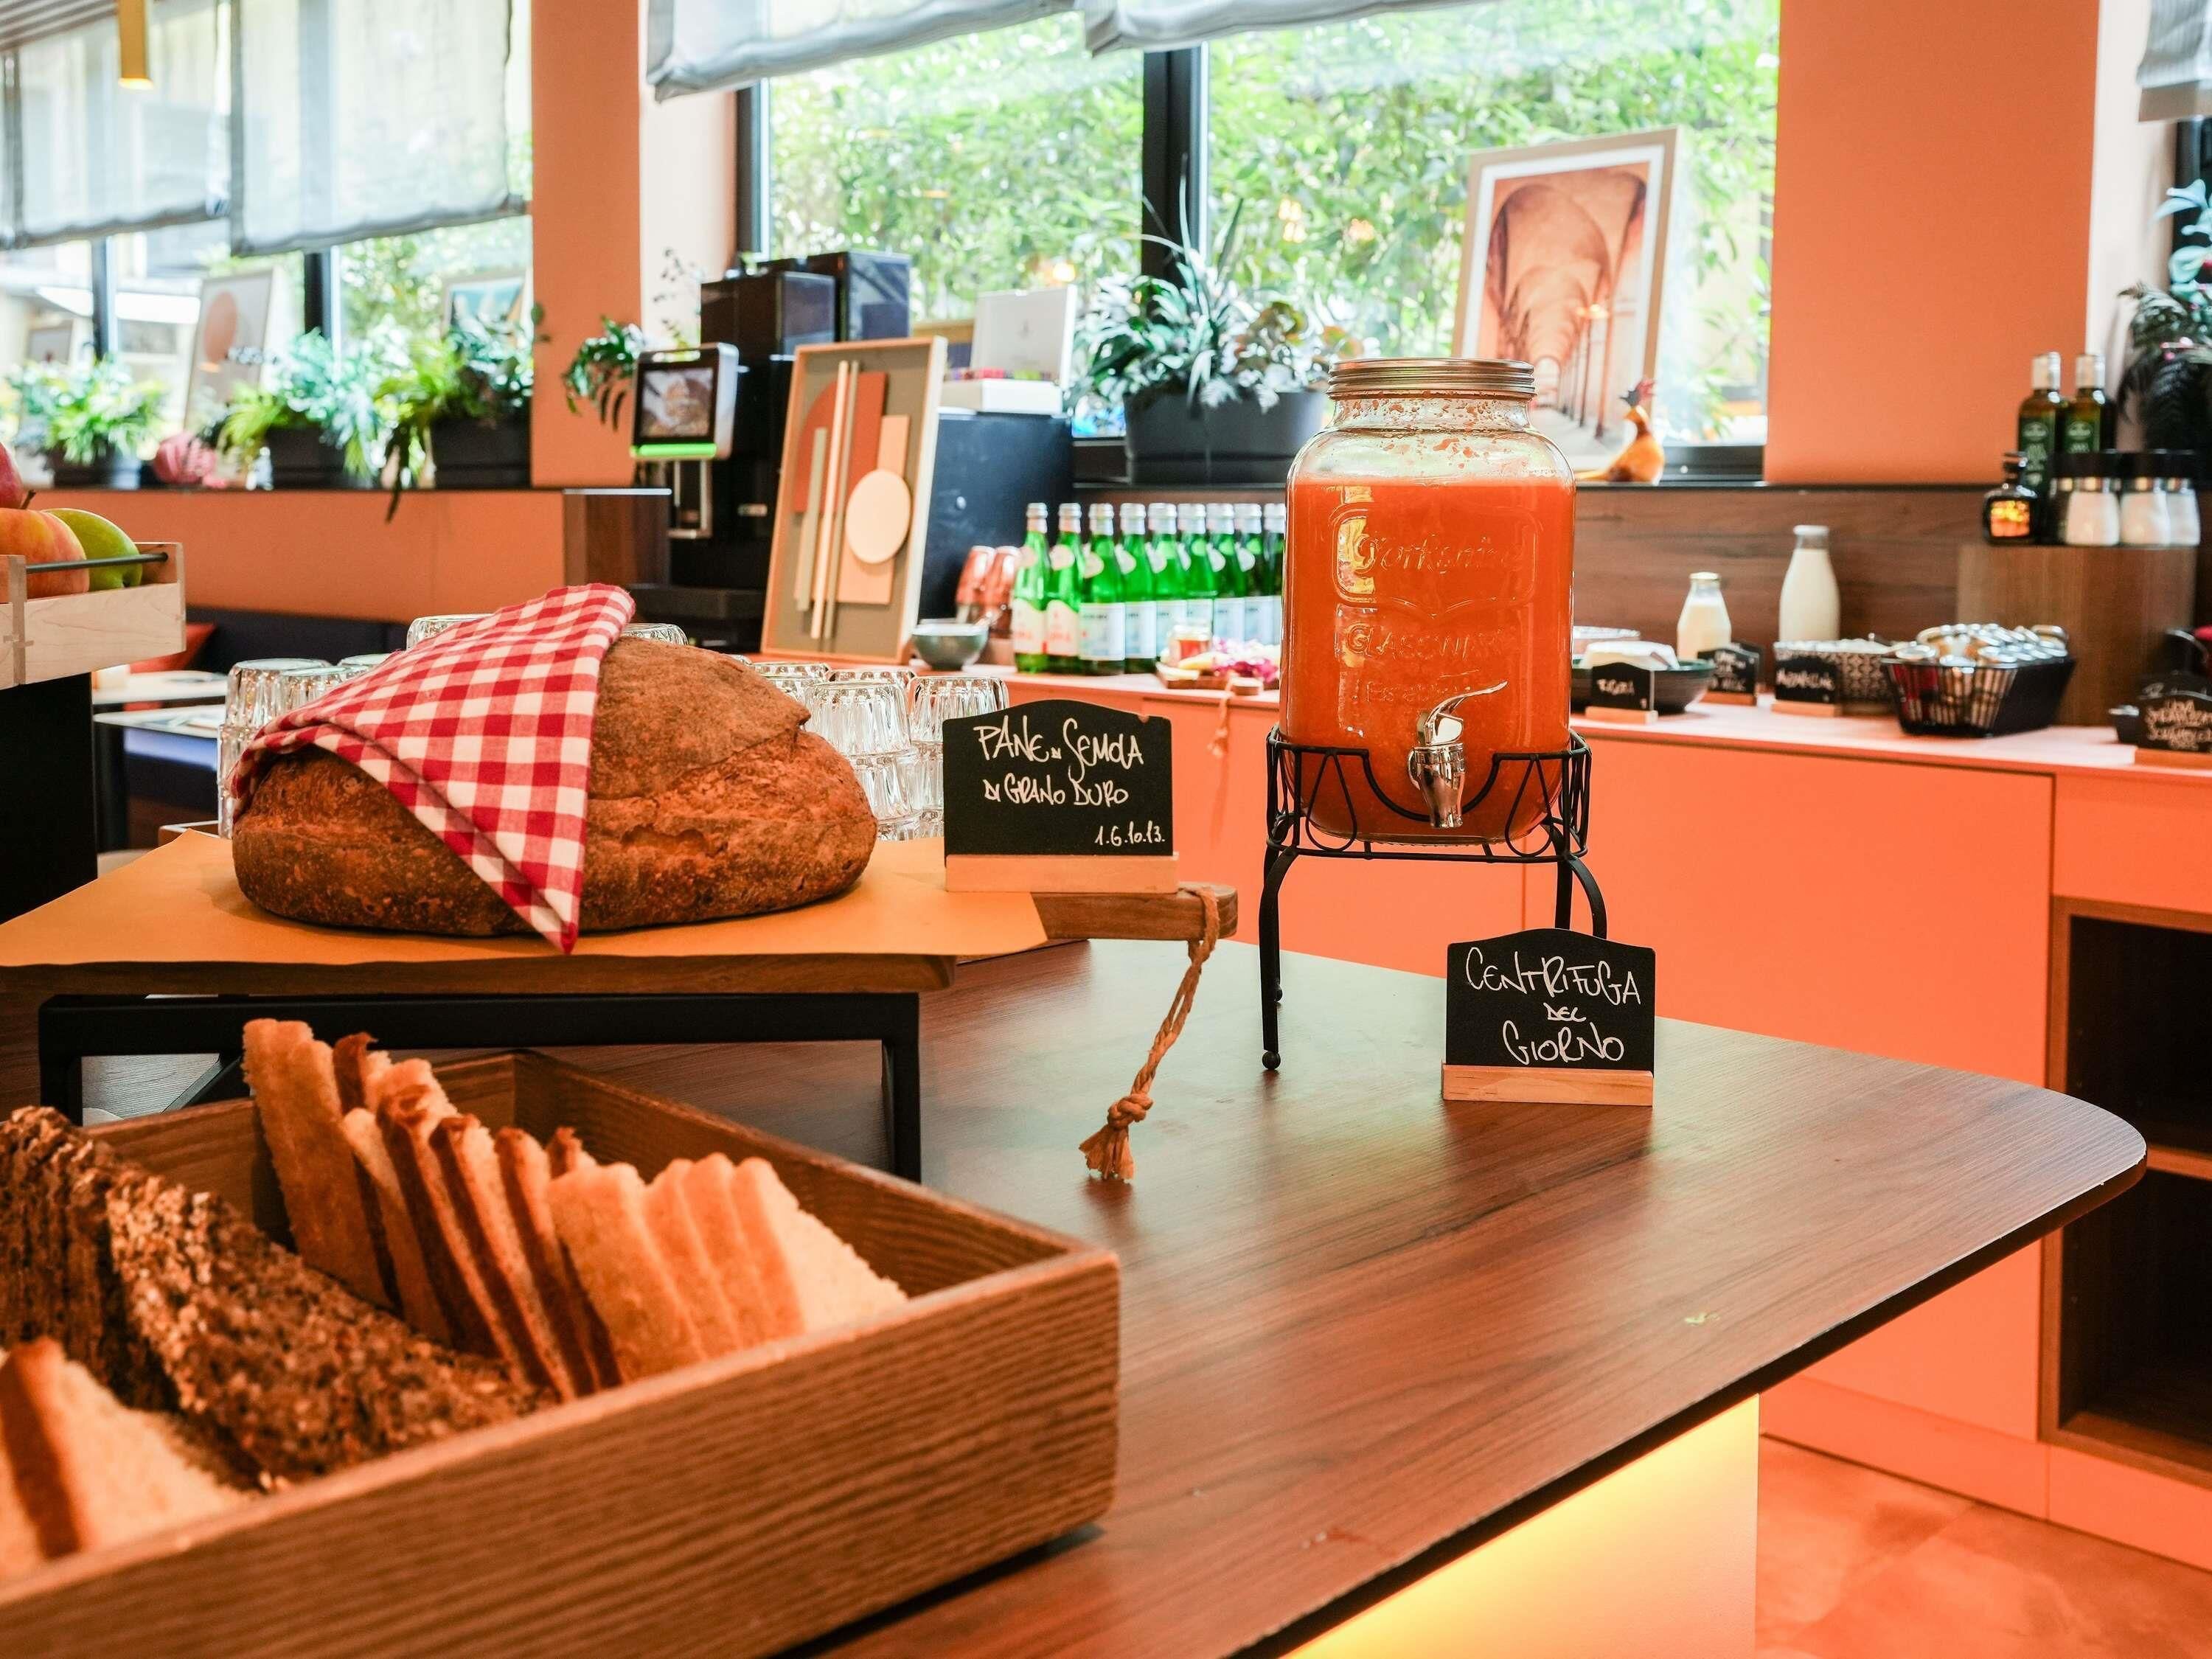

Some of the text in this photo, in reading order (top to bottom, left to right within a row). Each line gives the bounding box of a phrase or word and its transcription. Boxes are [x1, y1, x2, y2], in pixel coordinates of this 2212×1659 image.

[973, 714, 1049, 762] PANE
[1062, 717, 1144, 782] SEMOLA
[1004, 772, 1066, 806] GRANO
[1073, 779, 1129, 807] DURO
[1465, 946, 1641, 1006] CENTRIFUGA
[1543, 1002, 1587, 1023] DEL
[1502, 1019, 1625, 1065] GIORNO
